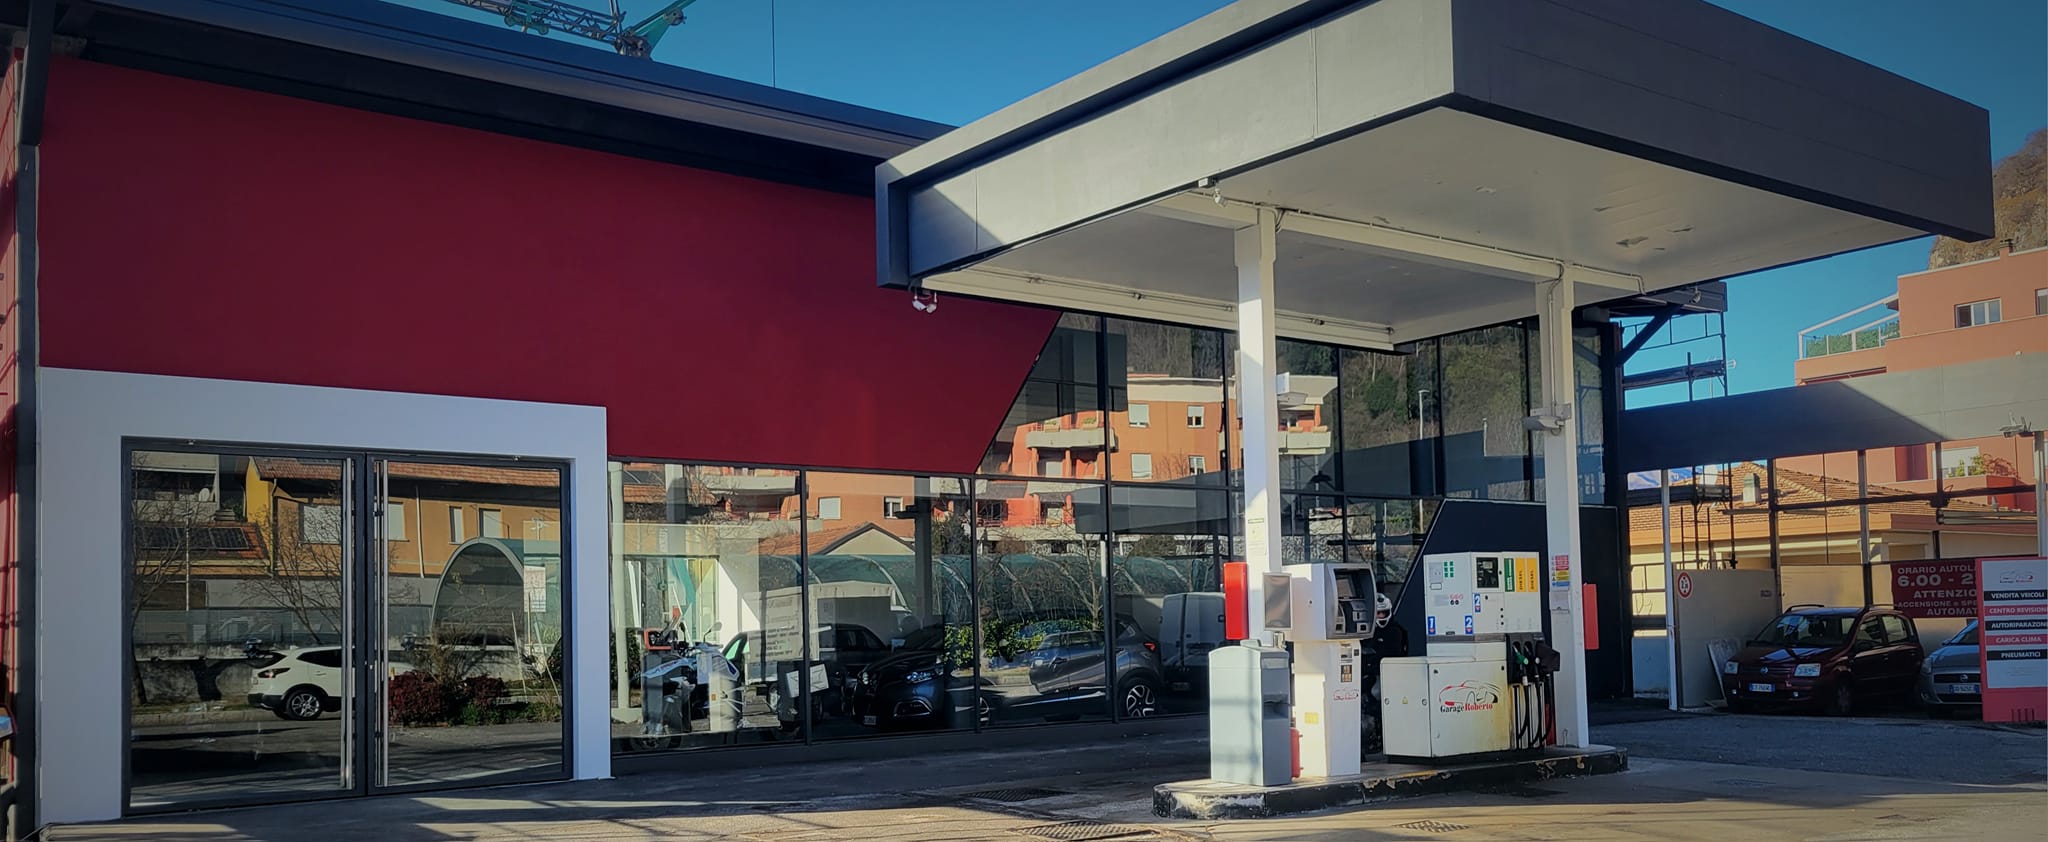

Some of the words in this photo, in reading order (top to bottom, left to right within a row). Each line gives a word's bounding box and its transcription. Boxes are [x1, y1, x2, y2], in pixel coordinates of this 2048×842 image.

[1897, 566, 1936, 574] ORARIO
[1897, 573, 1941, 587] 6.00
[1913, 588, 1977, 598] ATTENZIO
[1474, 595, 1480, 606] 2
[1429, 618, 1434, 628] 1
[1465, 617, 1473, 628] 2
